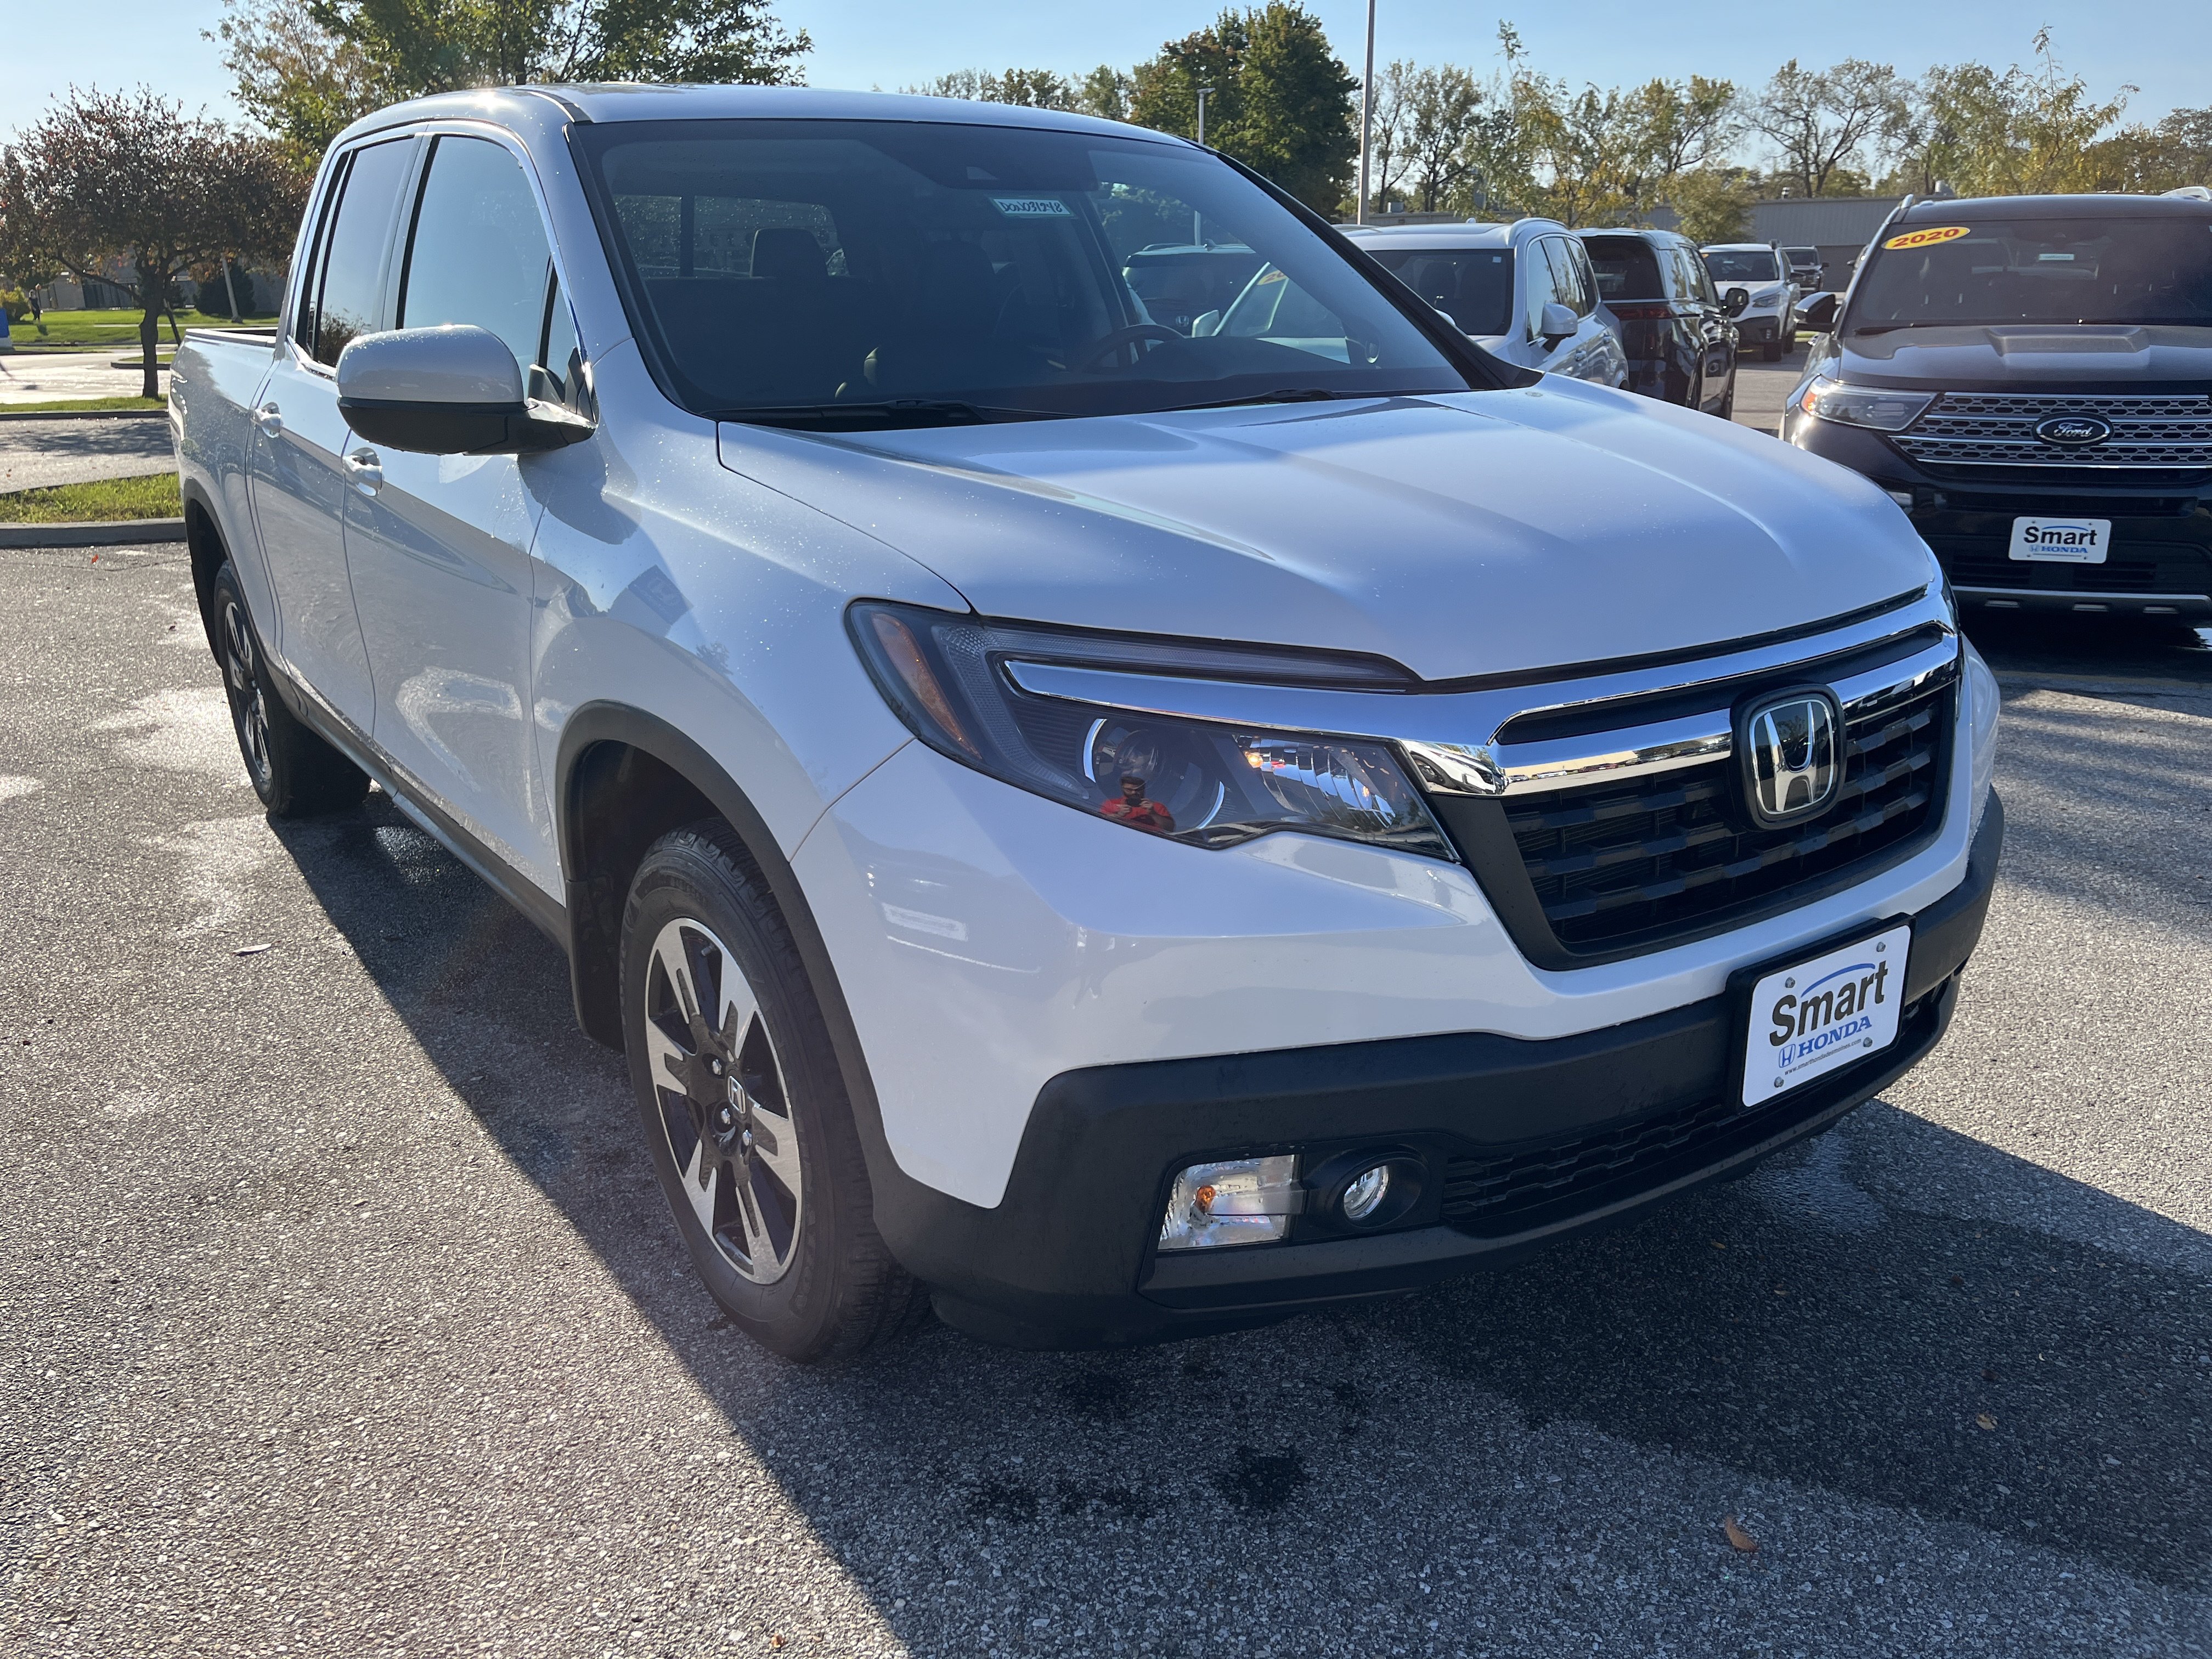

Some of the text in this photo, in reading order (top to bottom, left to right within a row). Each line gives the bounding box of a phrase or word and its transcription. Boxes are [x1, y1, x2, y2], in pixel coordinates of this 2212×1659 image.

[1893, 228, 1960, 247] 2020
[2053, 422, 2094, 437] Ford
[2023, 526, 2097, 545] Smart
[2041, 545, 2089, 554] HONDA
[1769, 960, 1888, 1046] Smart
[1797, 1015, 1872, 1058] HONDA
